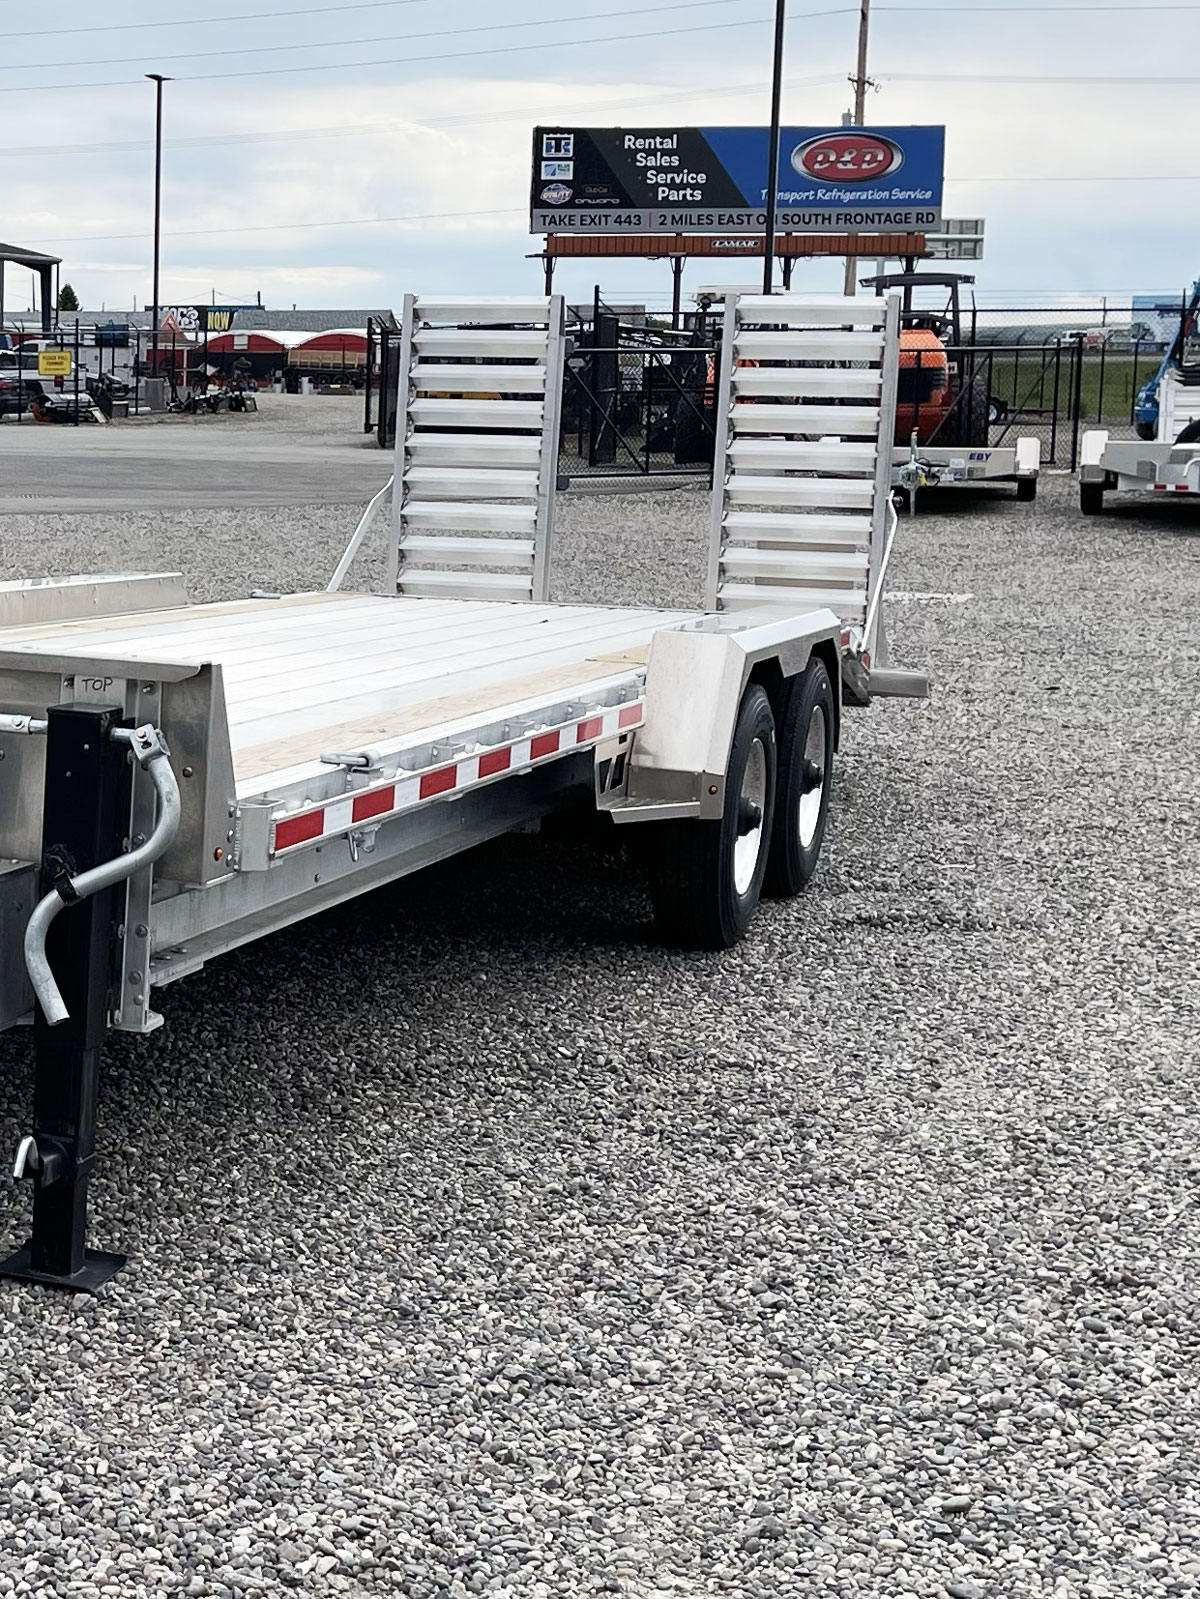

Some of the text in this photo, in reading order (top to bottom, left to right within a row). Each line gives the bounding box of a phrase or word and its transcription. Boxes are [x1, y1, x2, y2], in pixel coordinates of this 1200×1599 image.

[623, 134, 678, 149] Rental
[635, 151, 680, 167] Sales
[812, 148, 886, 170] D&D
[646, 168, 707, 184] Service
[657, 186, 702, 201] Parts
[760, 187, 933, 204] Tnsport Refrigeration Service
[540, 212, 935, 226] TAKE EXIT 443 2 MILES EAST O SOUTH FRONTAGE RD
[714, 240, 756, 248] LAMAR
[207, 311, 230, 330] NOW
[81, 676, 114, 693] TOP
